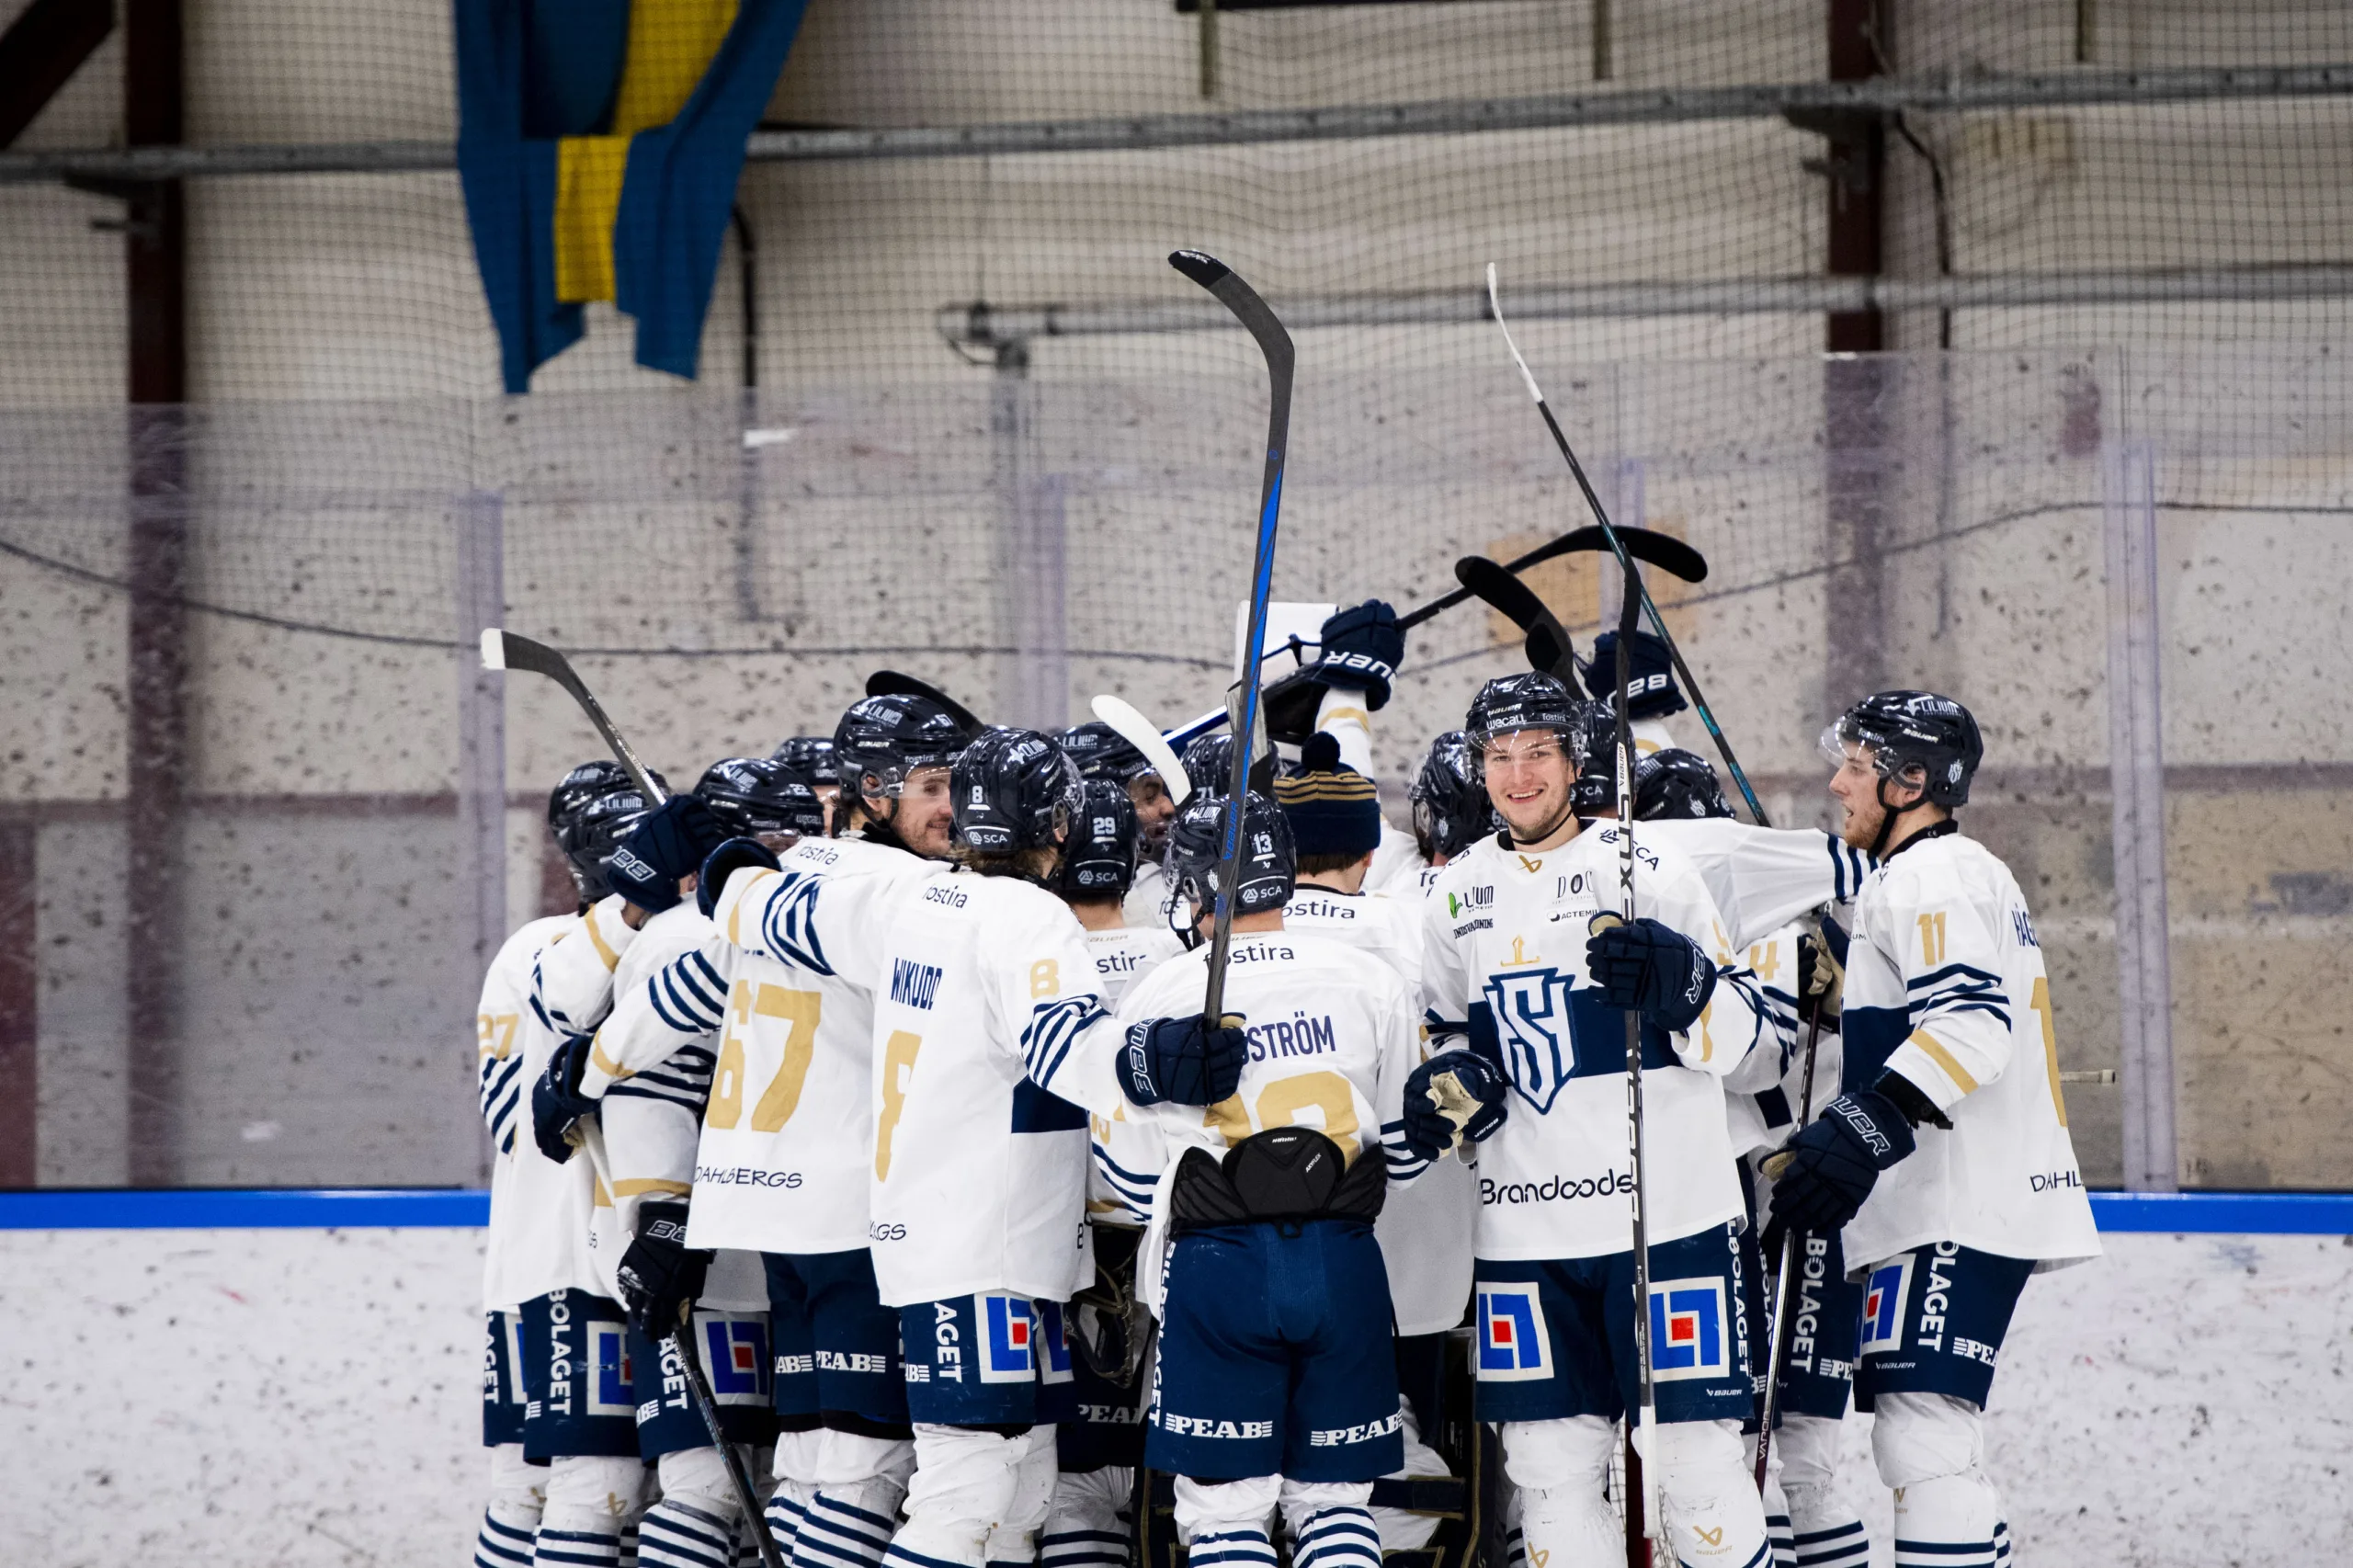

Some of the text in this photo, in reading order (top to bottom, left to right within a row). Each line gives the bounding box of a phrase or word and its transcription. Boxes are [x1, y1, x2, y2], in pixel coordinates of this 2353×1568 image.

[1486, 714, 1527, 730] wecall
[904, 755, 935, 764] fostira
[972, 785, 983, 804] 8
[1092, 816, 1116, 835] 29
[983, 834, 1008, 844] SCA
[1253, 833, 1274, 855] 13
[1096, 871, 1119, 882] SCA
[1260, 885, 1283, 899] SCA
[1916, 911, 1947, 967] 11
[1203, 943, 1295, 968] fstira
[1030, 960, 1060, 999] 8
[2029, 1170, 2086, 1193] DAHL
[934, 1301, 962, 1383] AGET
[1173, 1414, 1264, 1439] PEAB
[1324, 1412, 1402, 1447] PEAB
